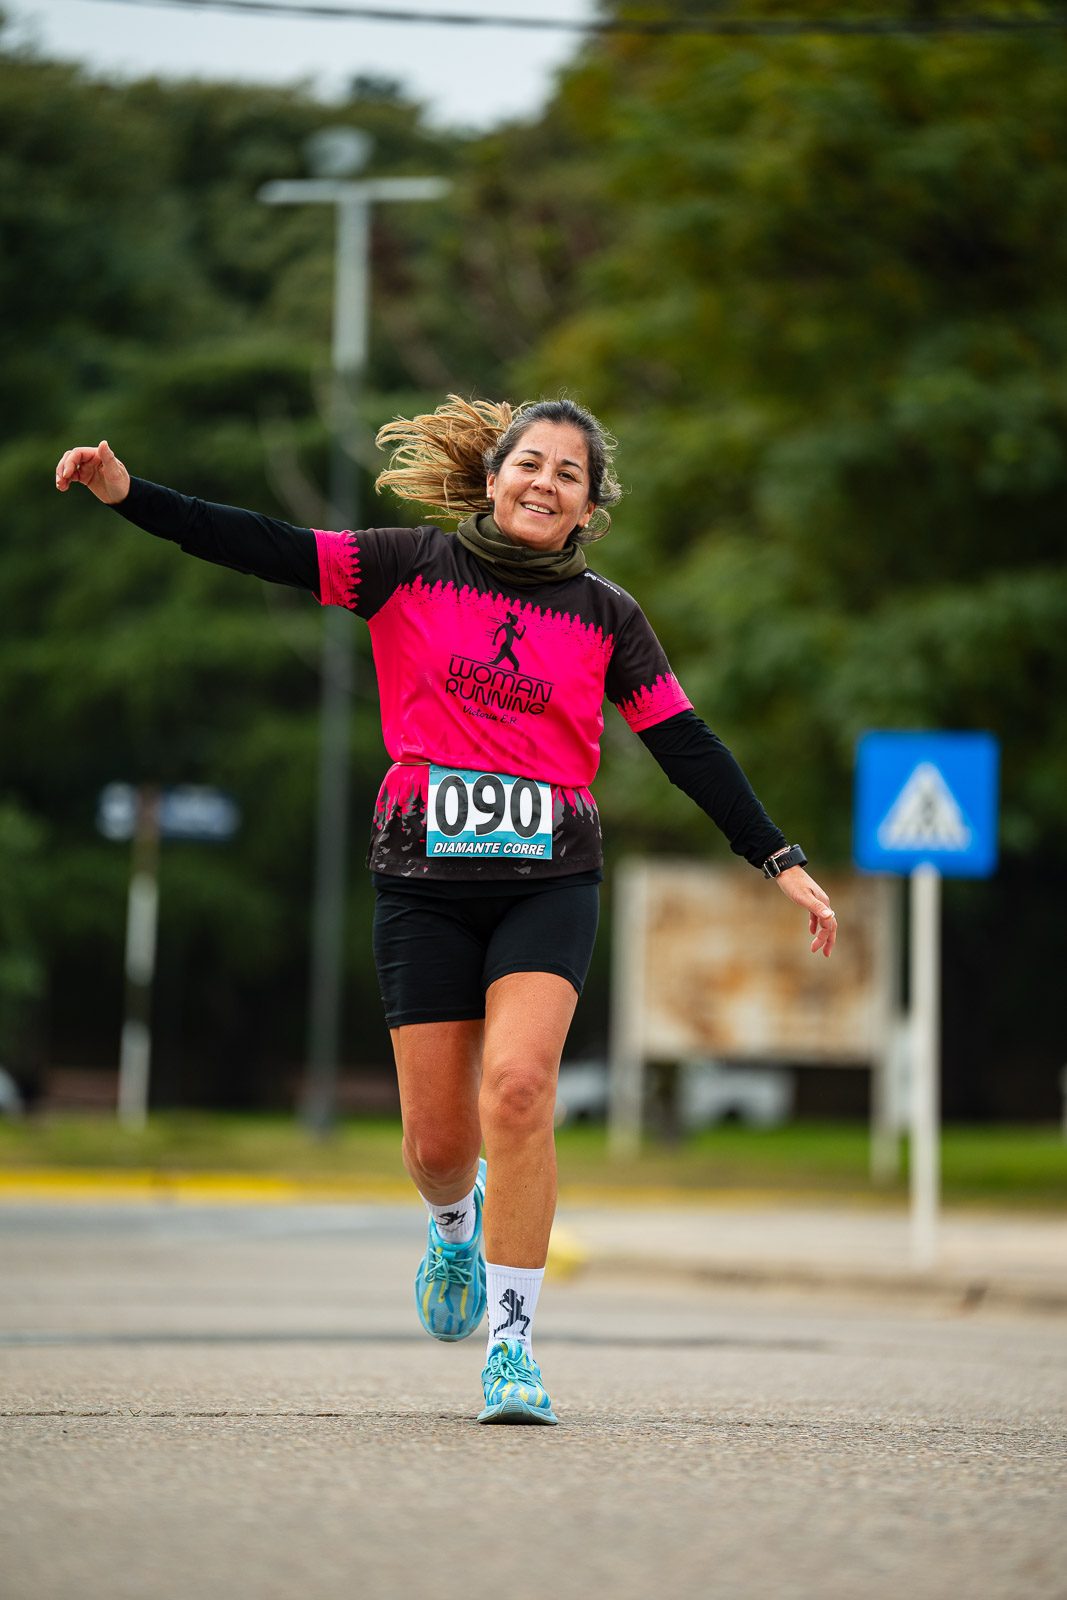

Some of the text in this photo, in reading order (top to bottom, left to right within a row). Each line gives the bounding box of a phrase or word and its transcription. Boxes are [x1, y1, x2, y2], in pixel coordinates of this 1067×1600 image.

[446, 678, 545, 715] RUNNING
[449, 658, 552, 703] WOMAN
[463, 705, 498, 721] Victoria
[435, 774, 542, 838] 090
[433, 842, 546, 856] DIAMANTE CORRE
